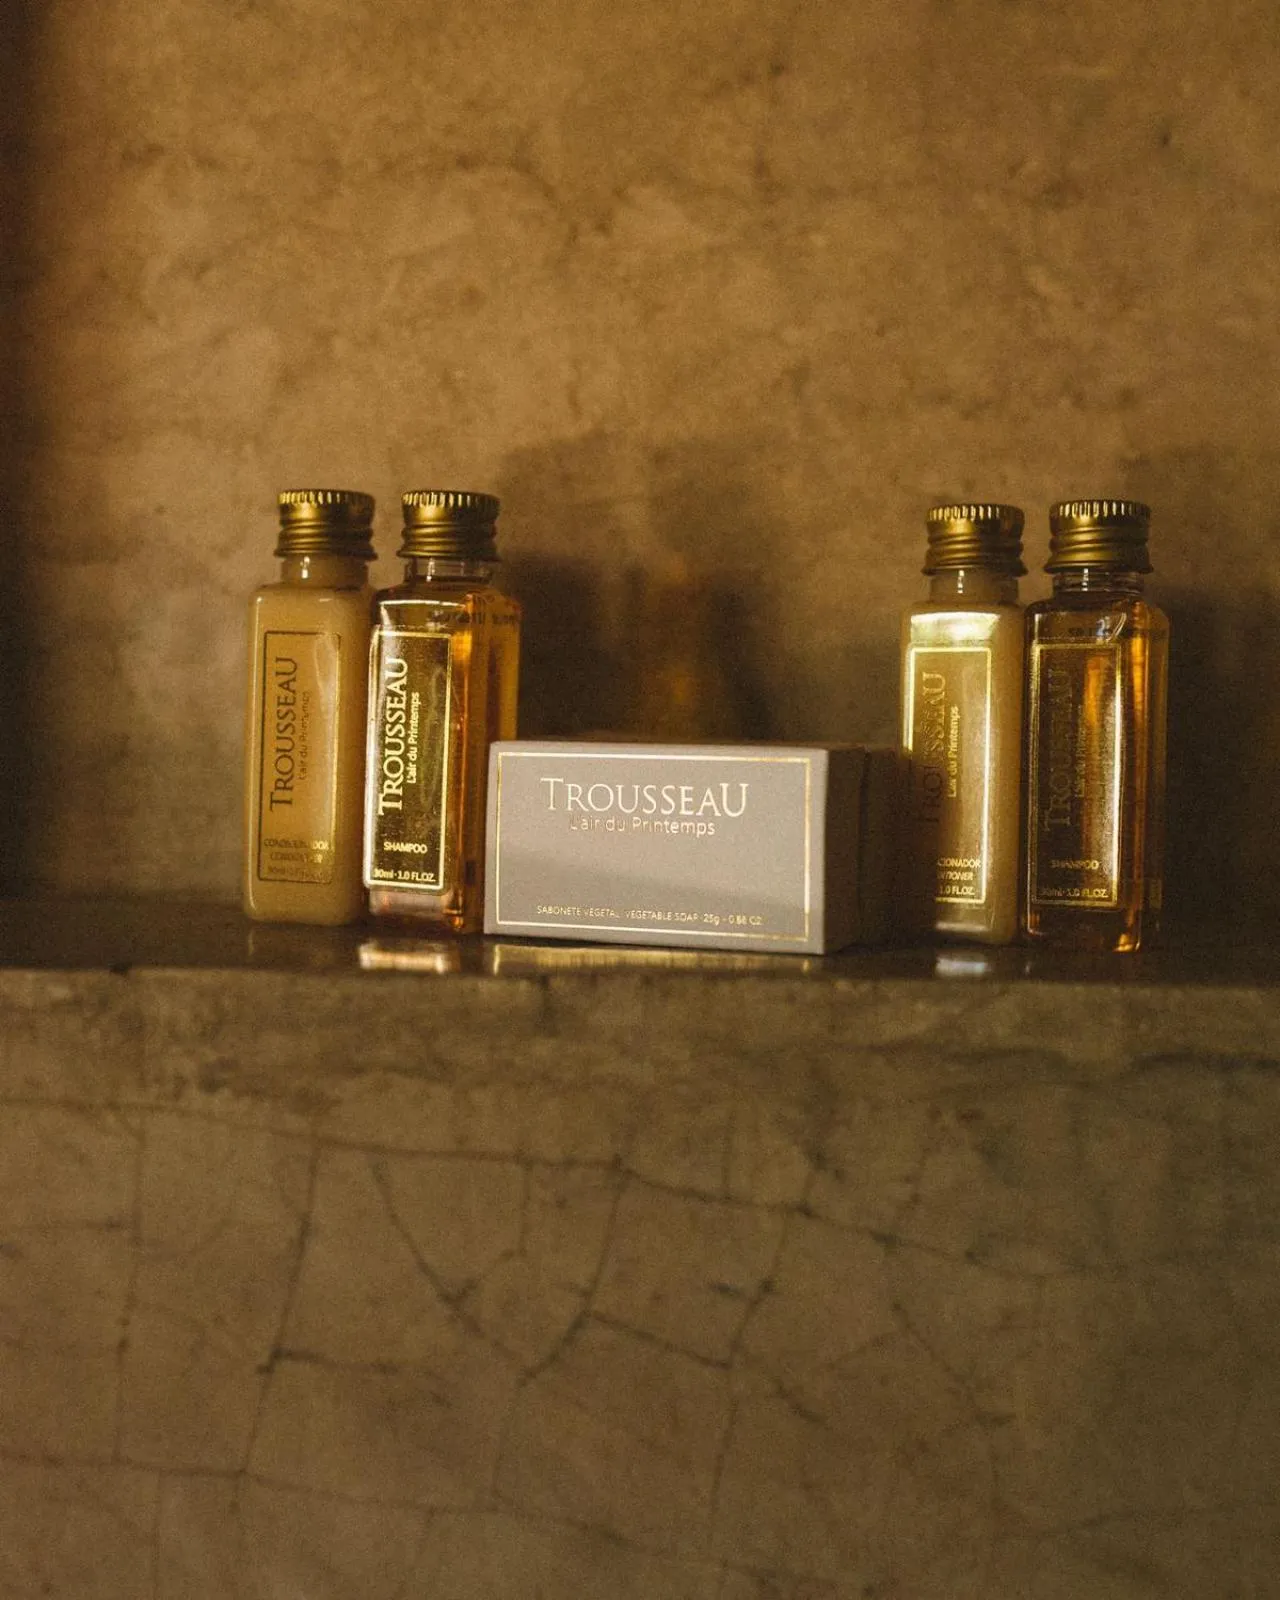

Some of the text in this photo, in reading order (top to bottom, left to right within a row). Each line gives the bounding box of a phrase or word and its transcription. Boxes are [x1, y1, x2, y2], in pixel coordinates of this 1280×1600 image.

[269, 656, 298, 812] TROUSSEAU
[377, 656, 409, 816] TROUSSEAU
[406, 691, 422, 784] L'air du Printemps
[540, 776, 750, 818] TROUSSEAU
[383, 841, 428, 854] SHAMPOO
[604, 817, 626, 832] du
[632, 816, 716, 838] Printemps
[537, 904, 582, 917] SABONETE
[625, 909, 674, 921] VEGETABLE
[674, 911, 699, 922] SOAP
[703, 912, 720, 927] 25g
